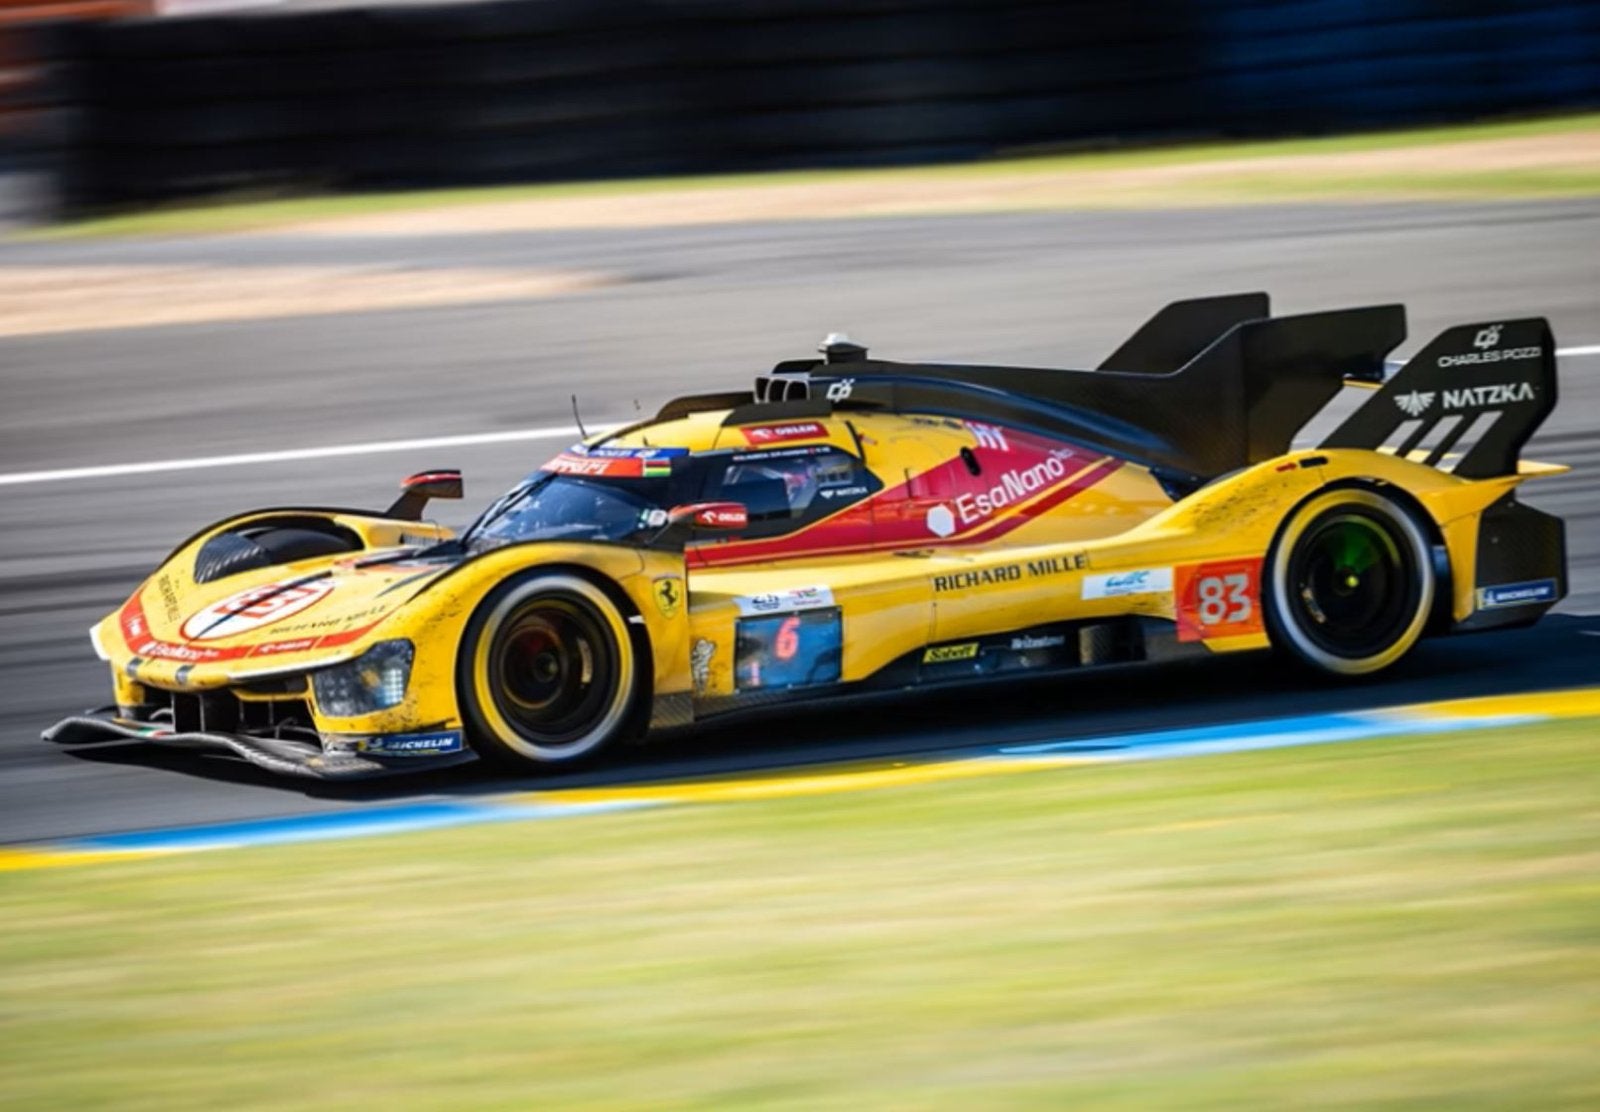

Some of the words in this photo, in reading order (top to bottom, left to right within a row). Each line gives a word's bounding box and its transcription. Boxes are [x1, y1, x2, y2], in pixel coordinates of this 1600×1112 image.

[1437, 352, 1500, 367] CHARLES
[1442, 382, 1534, 409] NATZKA
[934, 565, 1021, 591] RICHARD
[1028, 553, 1086, 577] MILLE
[1199, 573, 1252, 625] 83
[774, 616, 801, 660] 6
